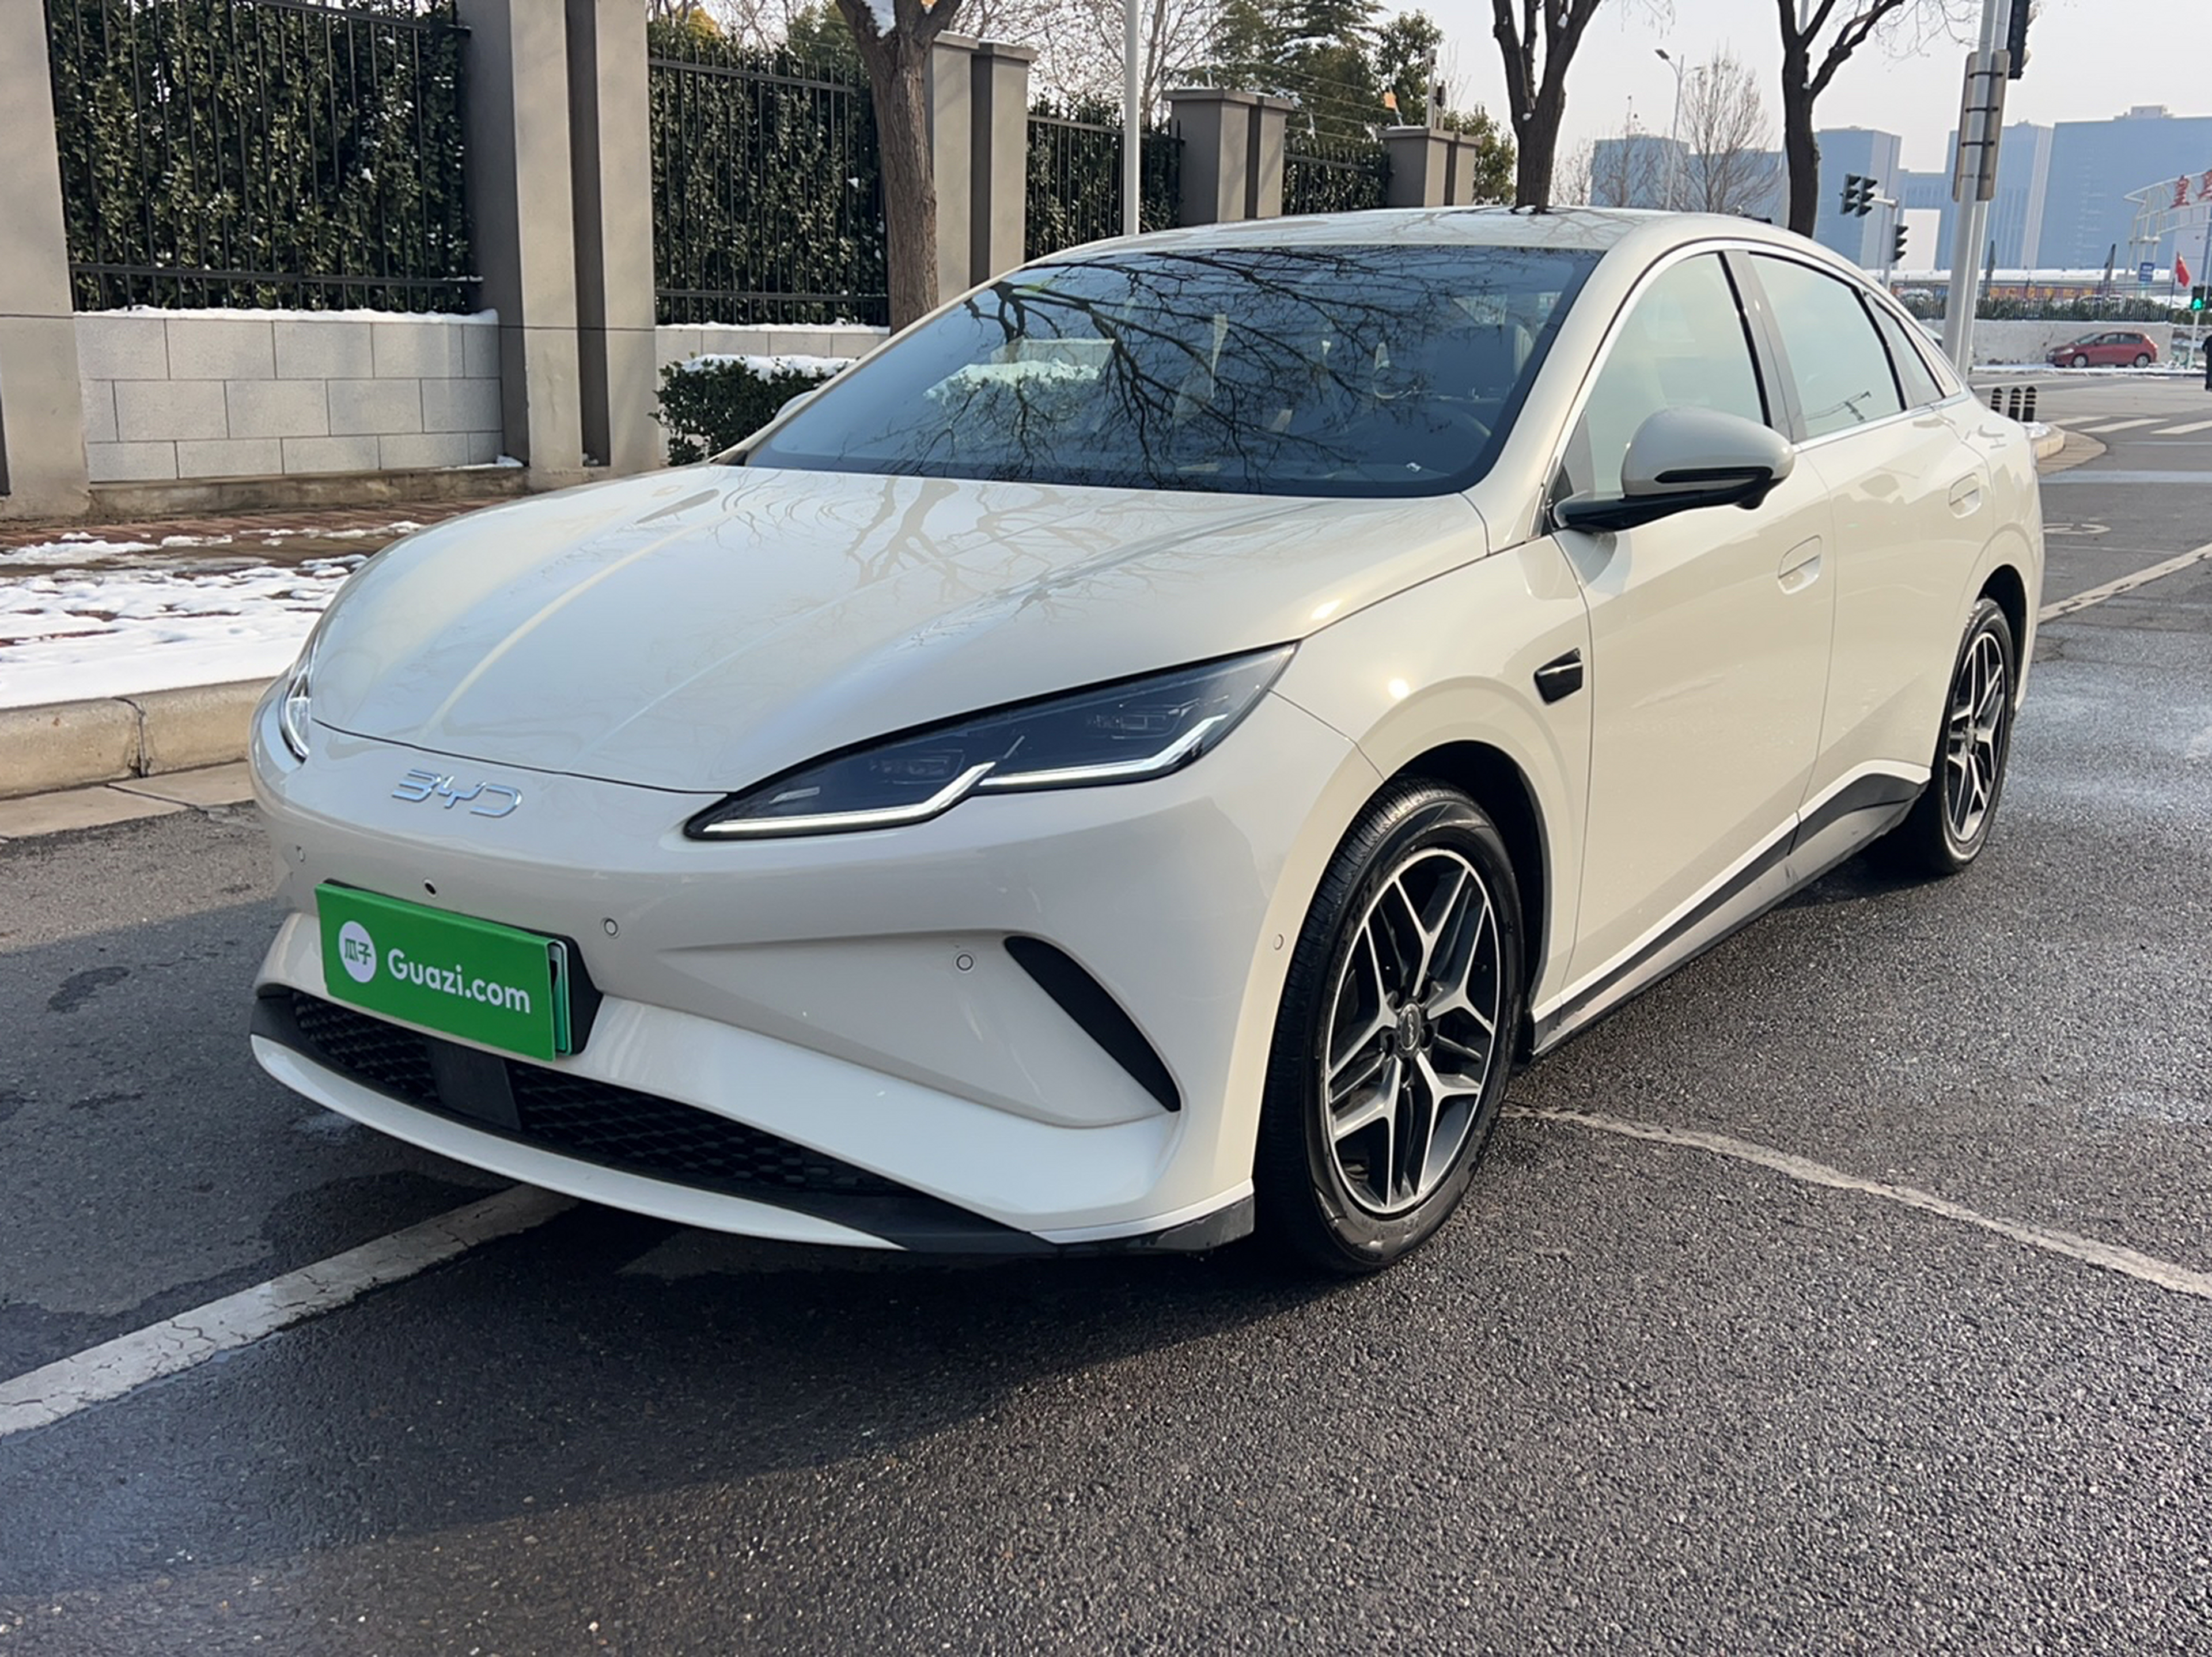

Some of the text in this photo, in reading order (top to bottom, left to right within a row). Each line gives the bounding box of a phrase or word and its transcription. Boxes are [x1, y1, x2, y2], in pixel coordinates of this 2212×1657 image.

[391, 768, 524, 818] BYD
[344, 938, 372, 965] 瓜子
[388, 948, 530, 1013] Guazi.com
